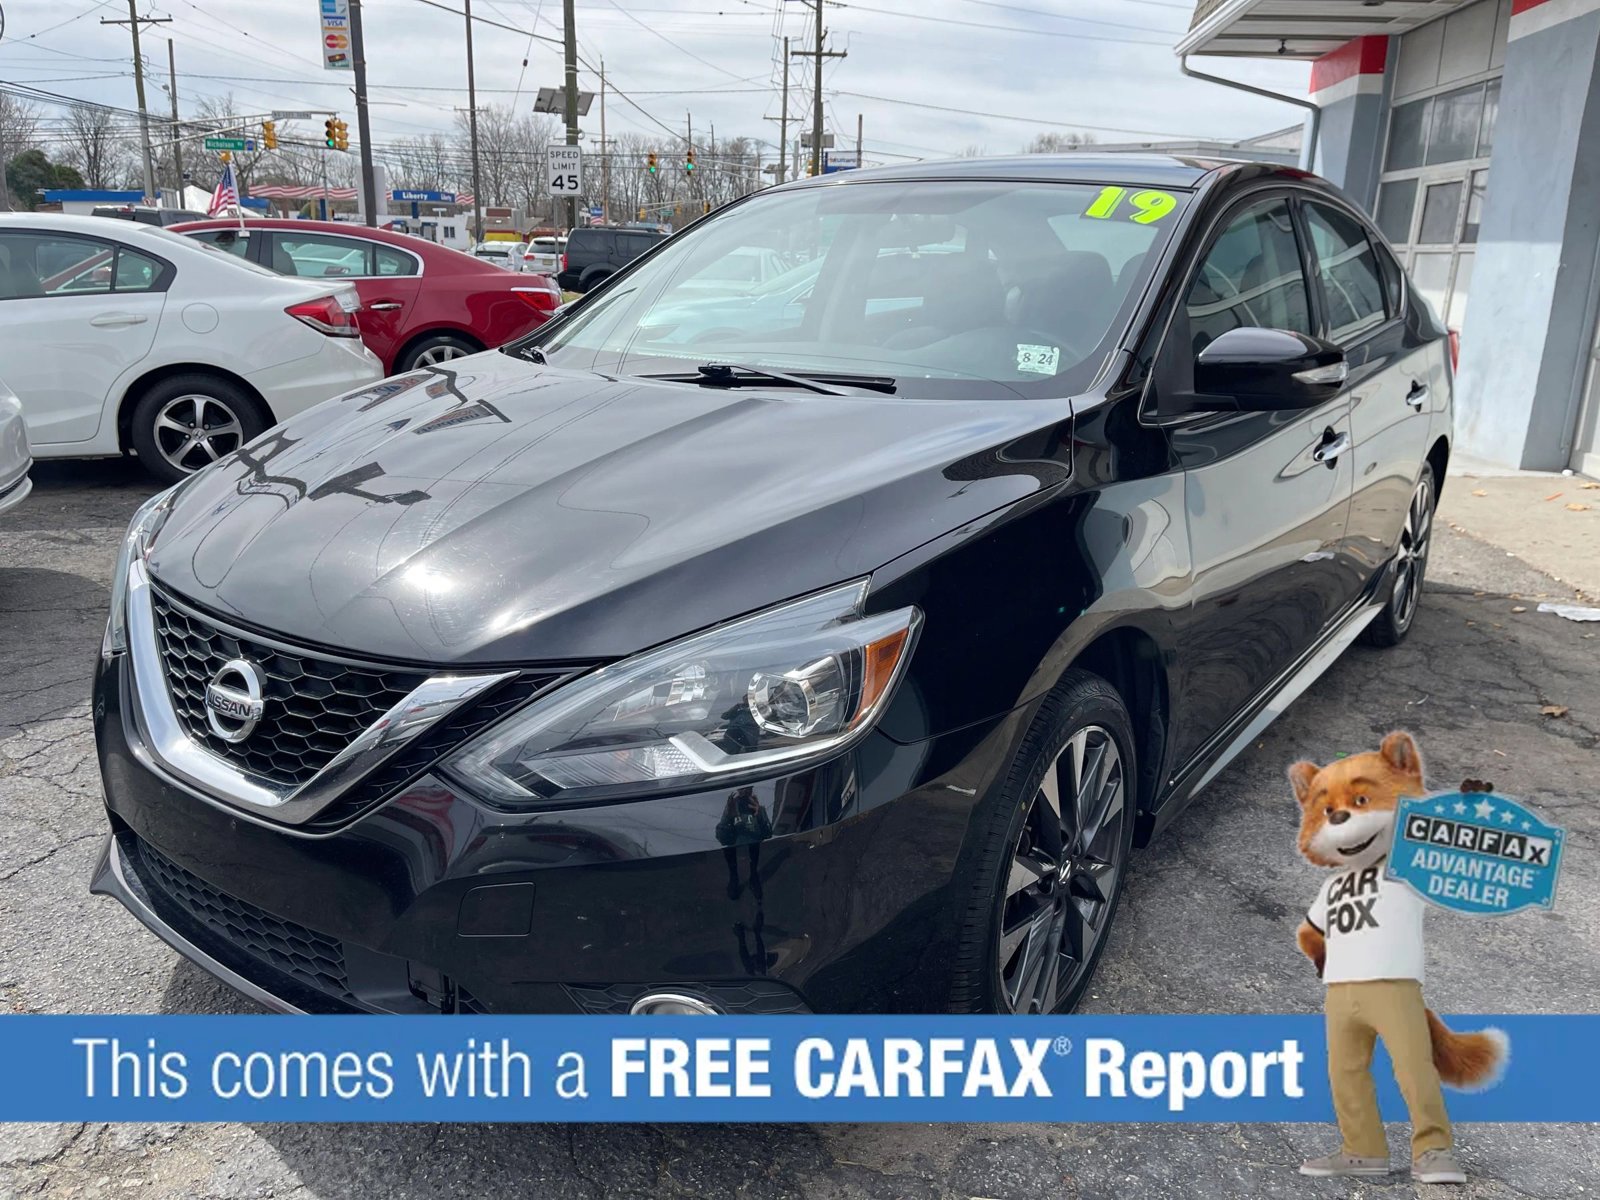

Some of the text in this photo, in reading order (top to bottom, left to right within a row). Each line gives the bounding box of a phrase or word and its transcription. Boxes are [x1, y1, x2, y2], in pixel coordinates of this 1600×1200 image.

[550, 150, 579, 159] SPEED
[551, 175, 579, 190] 45
[402, 192, 428, 200] Liberty
[1085, 186, 1177, 224] 19
[1023, 352, 1054, 366] 8 24
[207, 691, 251, 716] NISSAN
